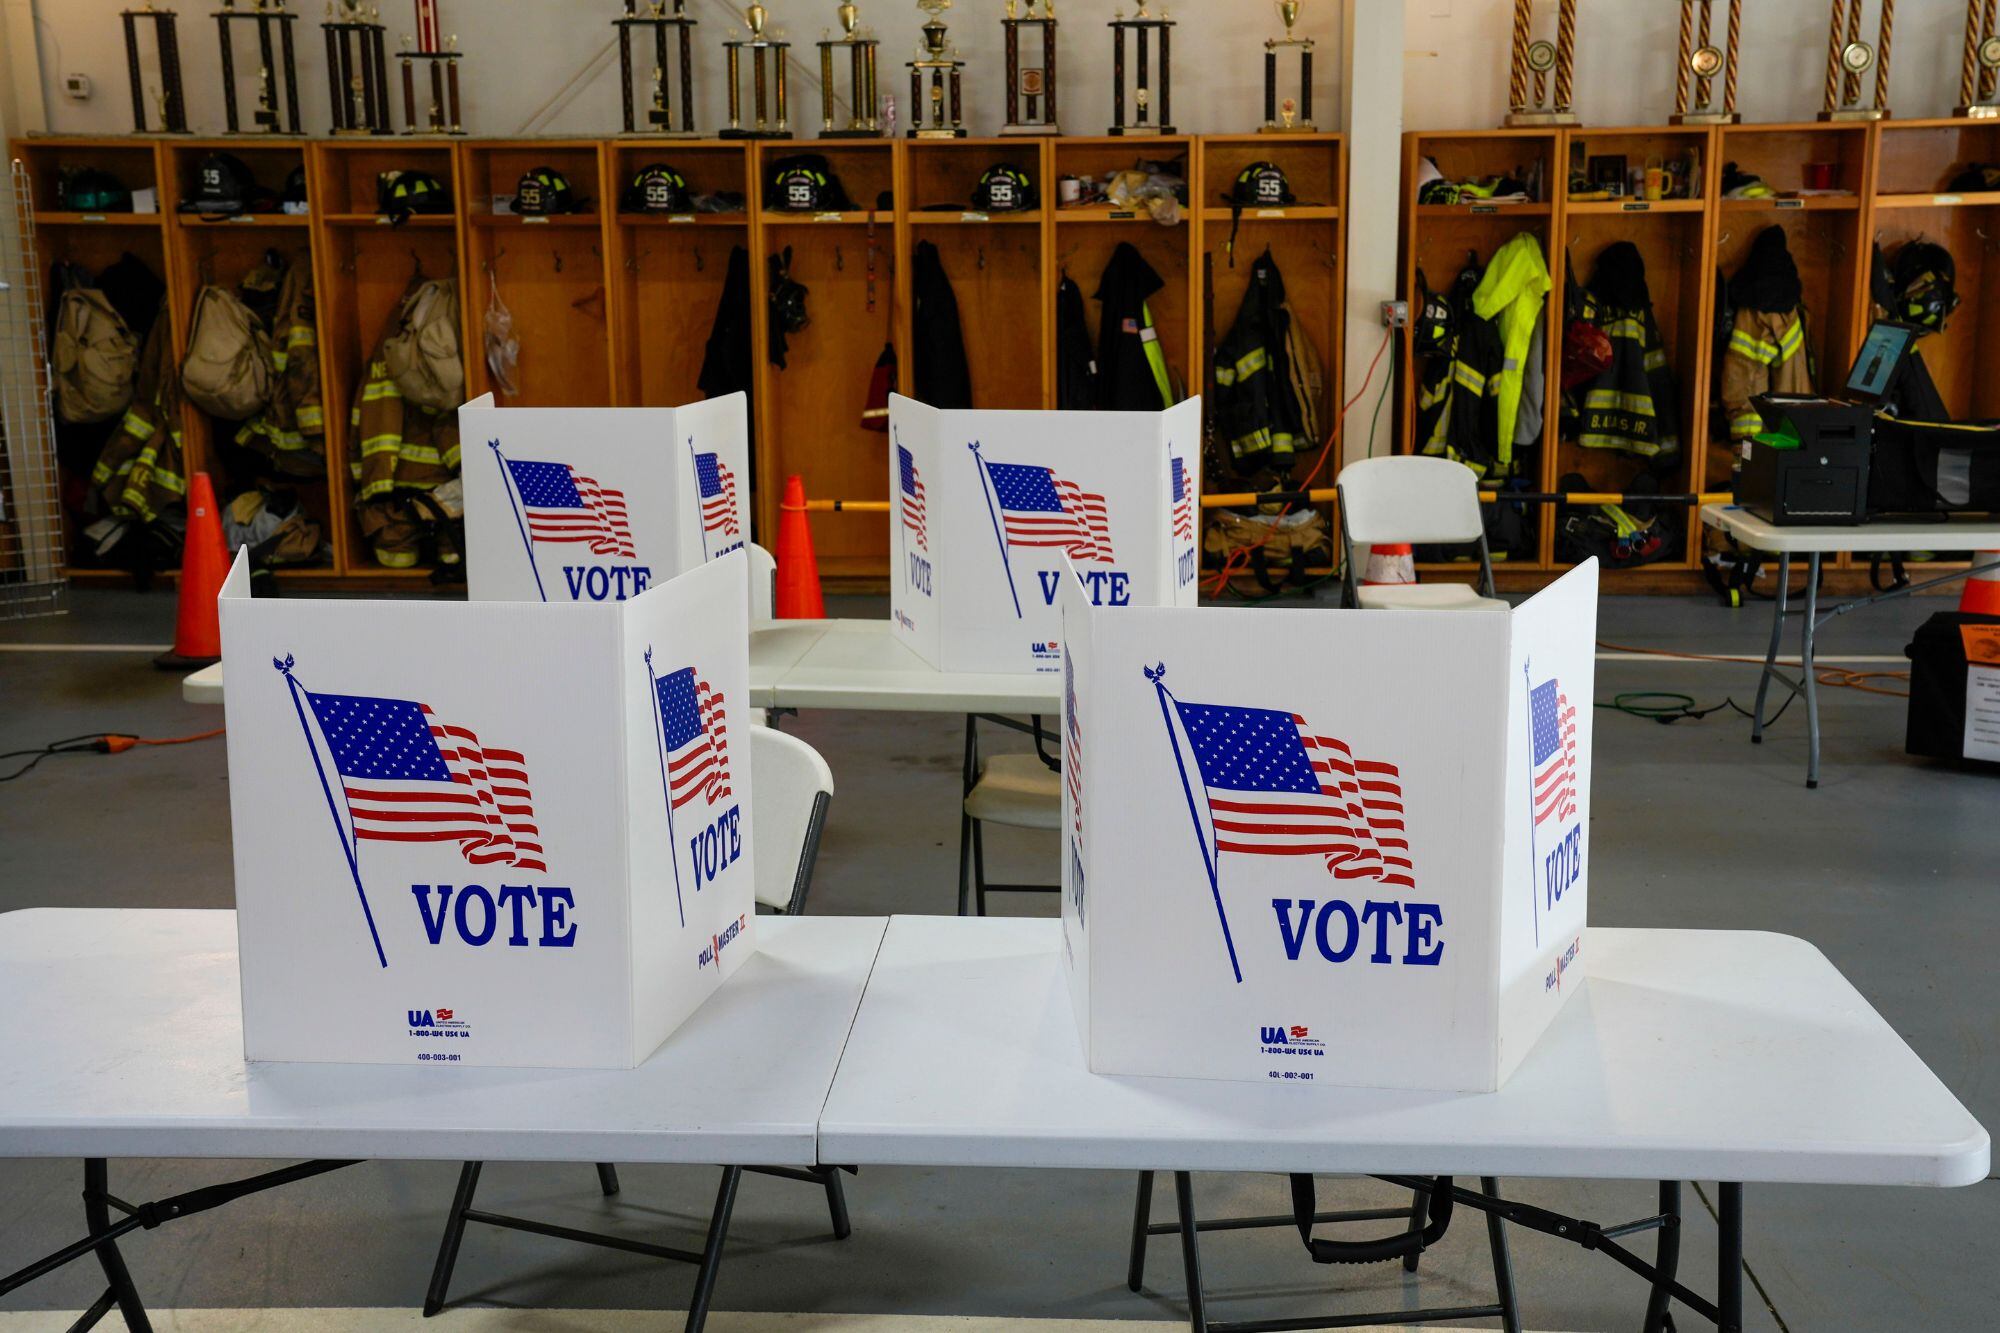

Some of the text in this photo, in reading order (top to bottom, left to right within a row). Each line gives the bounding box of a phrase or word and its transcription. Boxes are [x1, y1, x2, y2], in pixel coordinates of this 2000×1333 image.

[521, 188, 540, 204] 55
[646, 185, 669, 202] 55
[788, 185, 810, 202] 55
[990, 185, 1012, 202] 55
[1259, 179, 1280, 196] 55
[911, 551, 932, 597] VOTE
[1178, 547, 1194, 589] VOTE
[563, 565, 653, 601] VOTE
[1037, 570, 1131, 606] VTE
[1032, 642, 1047, 653] UA
[690, 803, 742, 892] VOTE
[1545, 822, 1581, 911] VOTE
[411, 884, 578, 948] VOTE
[698, 944, 714, 970] POLL
[718, 919, 740, 952] MASTER
[1271, 898, 1445, 966] VOTE
[1545, 967, 1557, 993] POLL
[408, 1010, 435, 1027] UA
[1261, 1027, 1288, 1044] UA
[418, 1053, 461, 1061] 400-003-001
